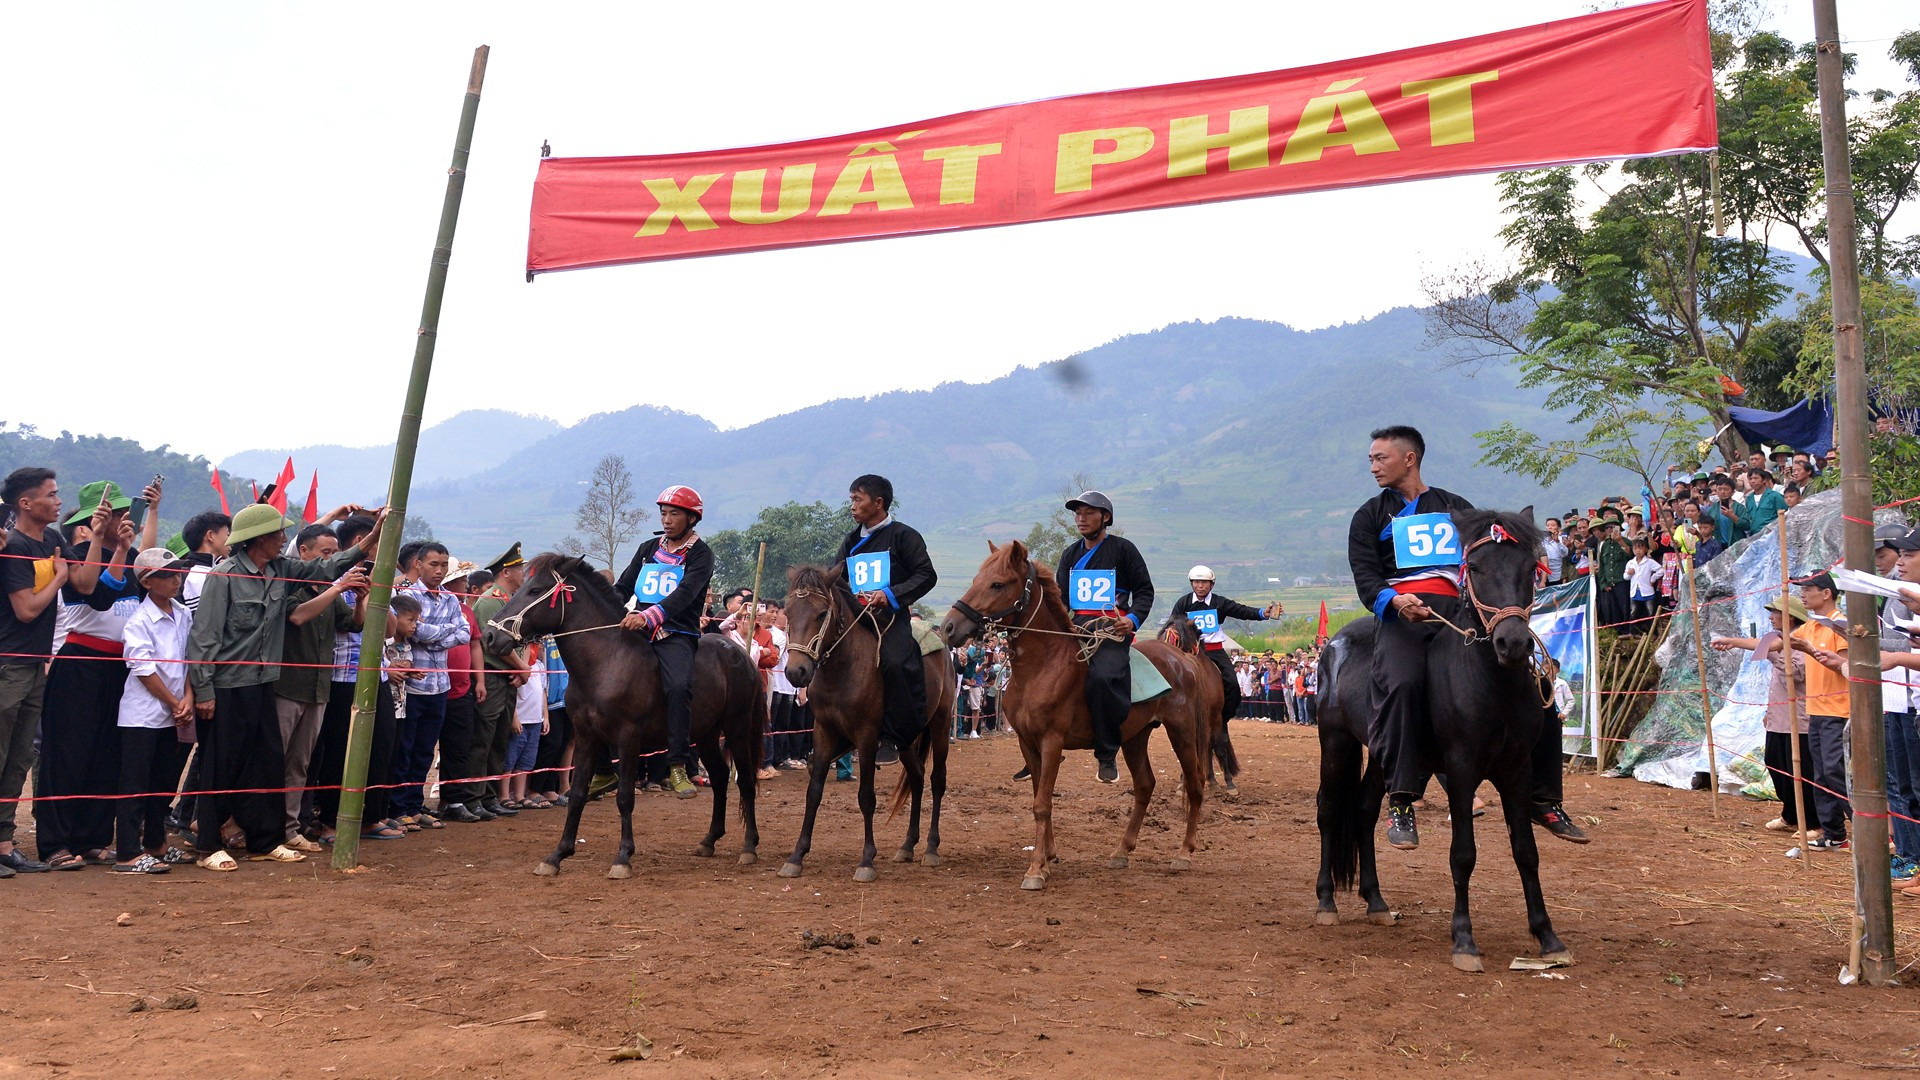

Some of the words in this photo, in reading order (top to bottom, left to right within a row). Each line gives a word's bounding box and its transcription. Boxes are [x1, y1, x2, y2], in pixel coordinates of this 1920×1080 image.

[633, 129, 1003, 238] XUẤT
[1054, 69, 1499, 194] PHÁT
[1407, 522, 1457, 557] 52
[642, 570, 678, 597] 56
[854, 559, 882, 586] 81
[1076, 577, 1112, 602] 82
[1193, 613, 1216, 630] 59
